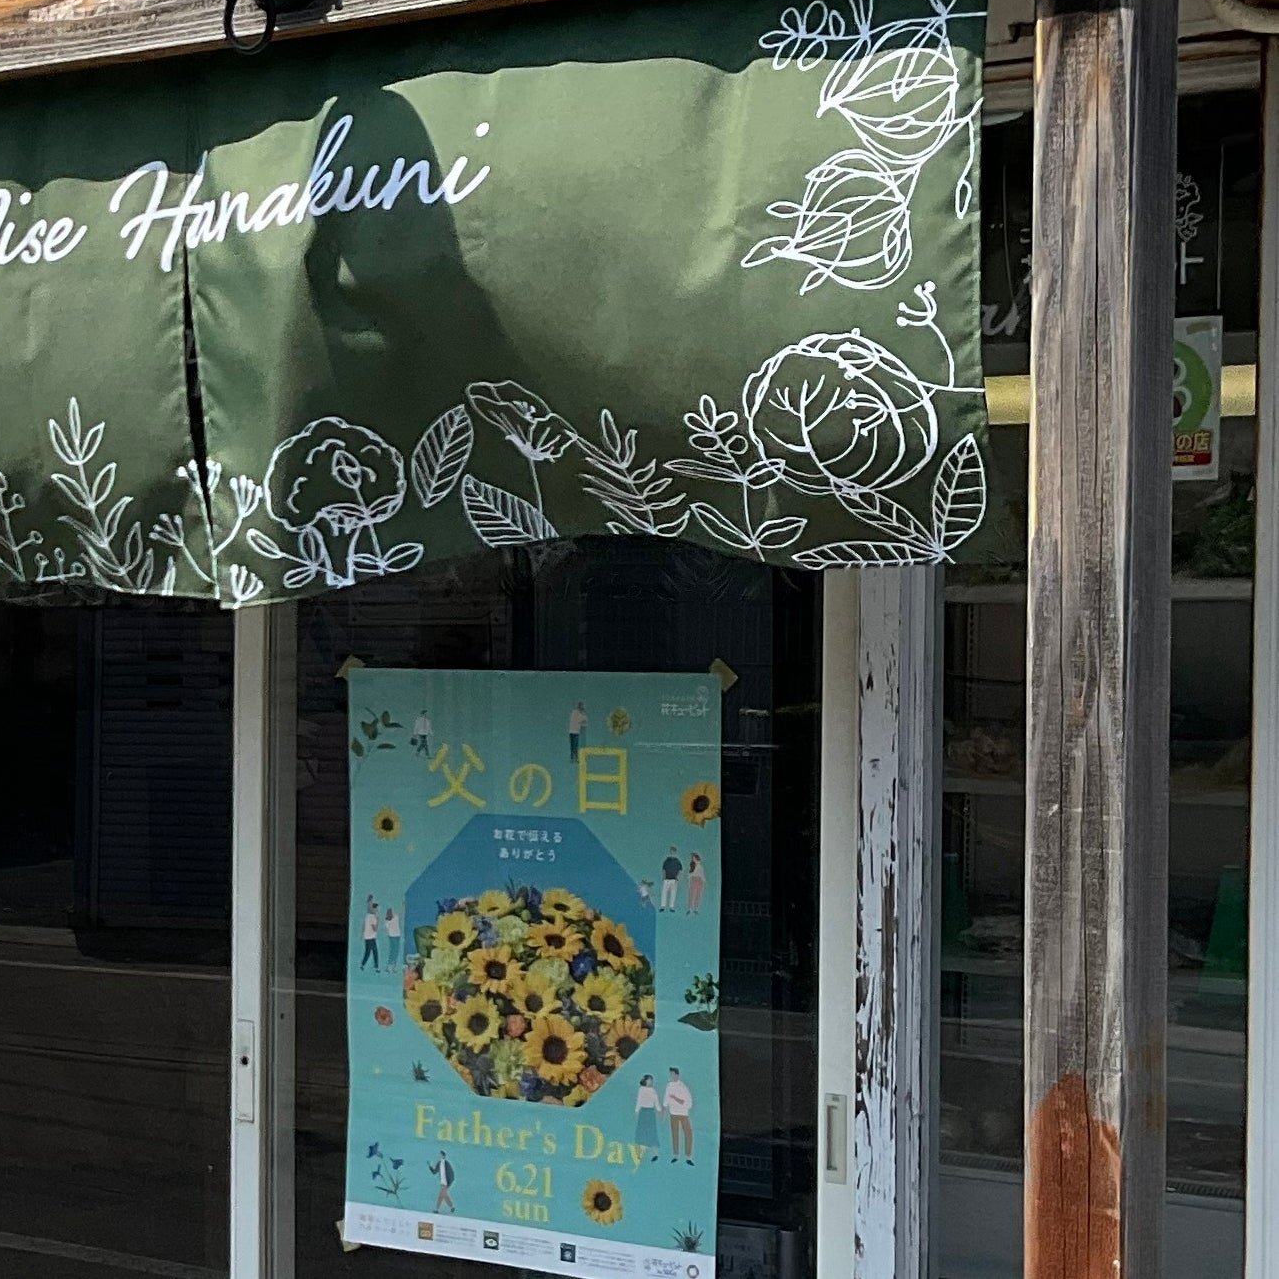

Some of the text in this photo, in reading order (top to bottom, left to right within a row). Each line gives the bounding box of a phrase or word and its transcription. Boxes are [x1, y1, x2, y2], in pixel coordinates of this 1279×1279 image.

[108, 114, 492, 273] Hanakuni
[426, 742, 628, 815] 父の日
[498, 847, 556, 862] ありがとう
[414, 1103, 646, 1172] Father's Day
[494, 1160, 555, 1199] 6.21
[501, 1199, 550, 1223] sun
